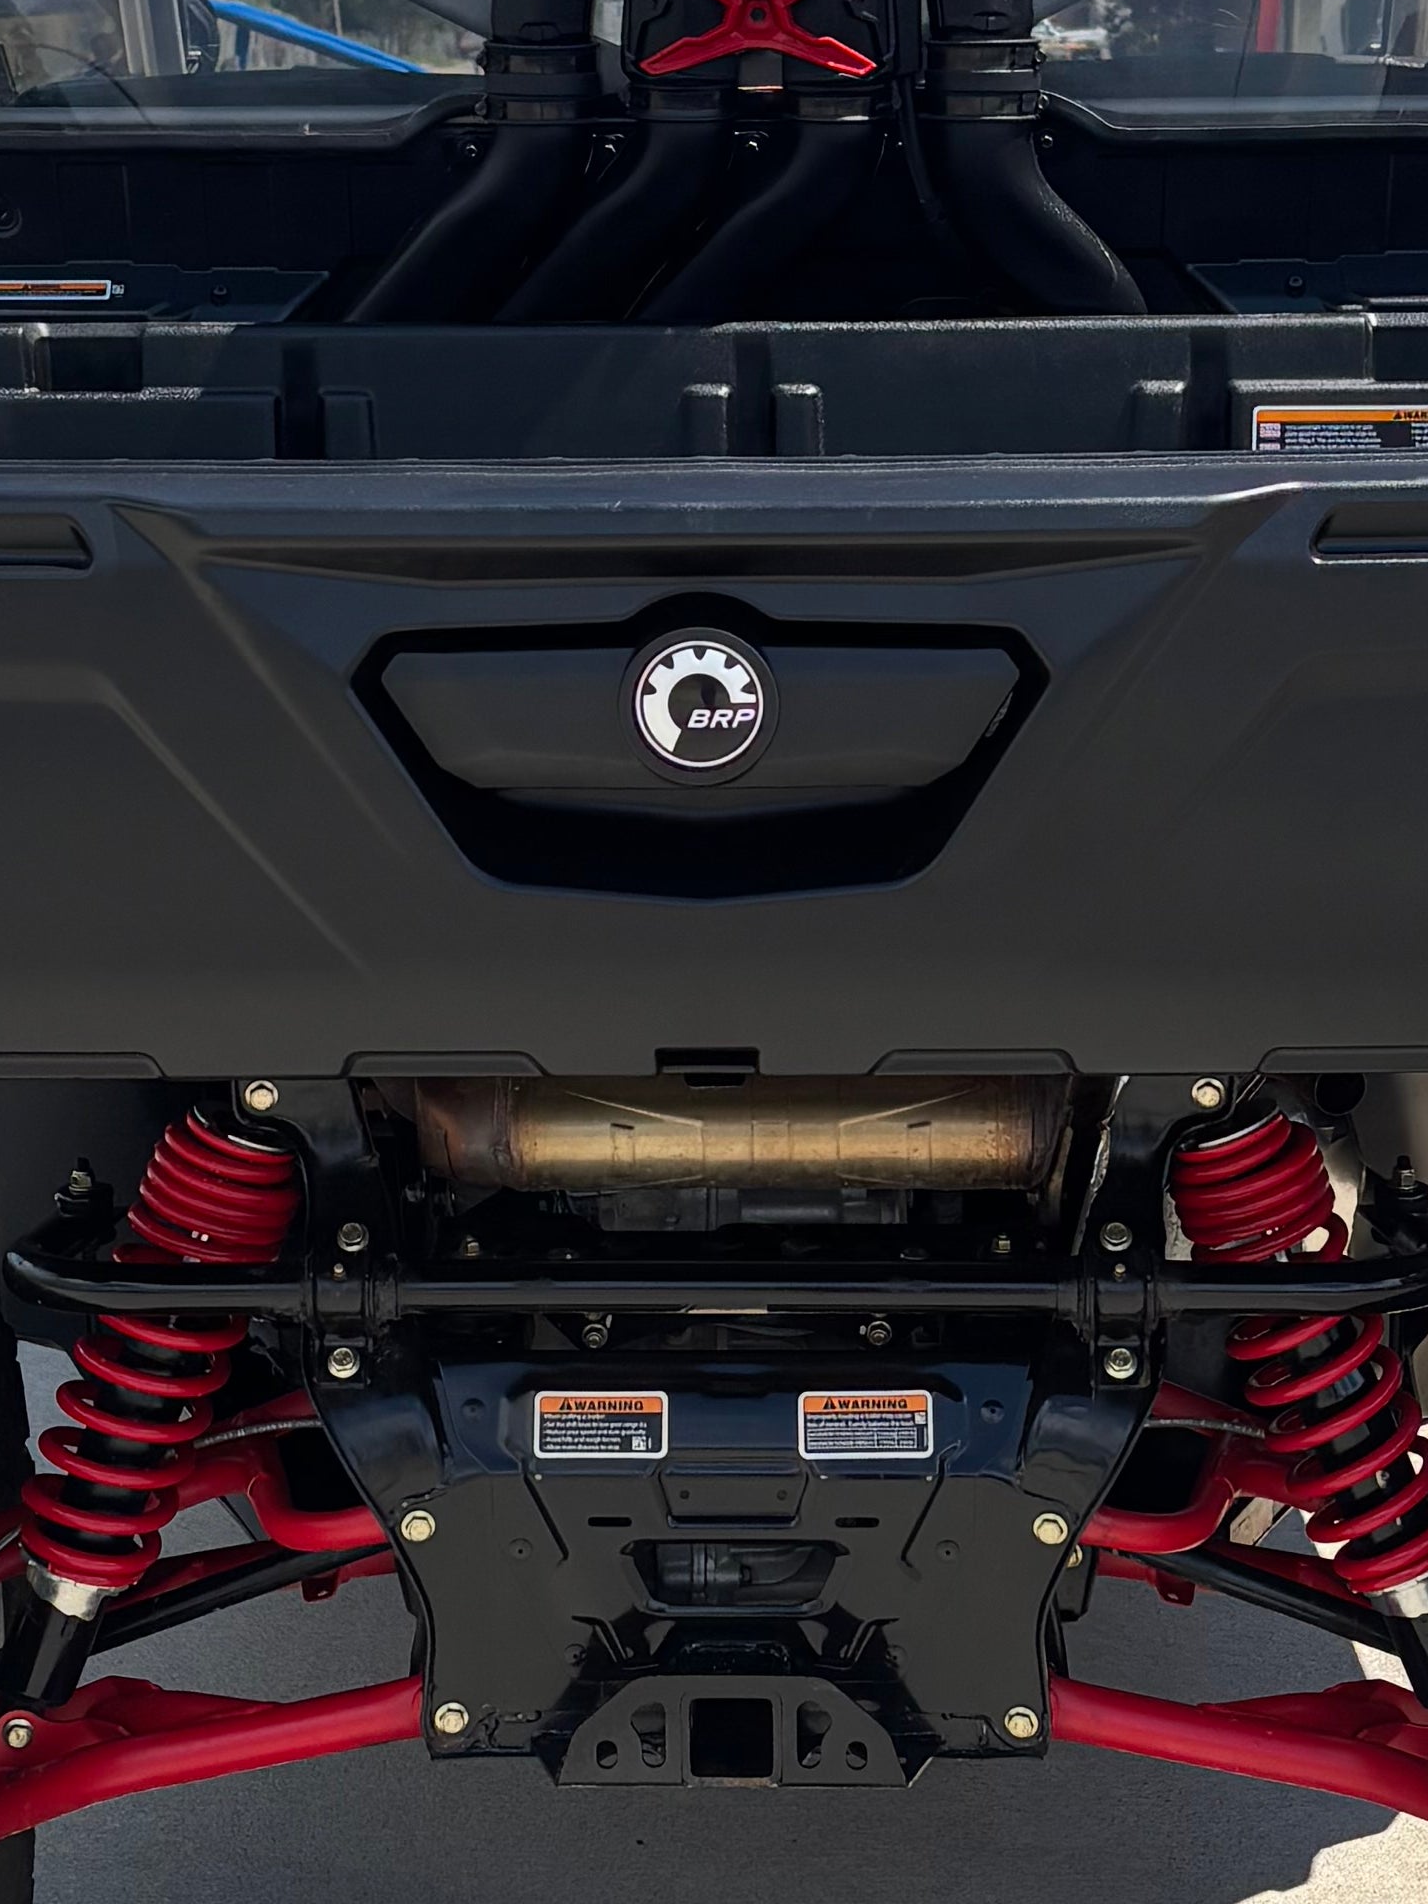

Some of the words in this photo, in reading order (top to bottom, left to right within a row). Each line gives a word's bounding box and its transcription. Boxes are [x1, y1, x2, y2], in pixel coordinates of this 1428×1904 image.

[687, 708, 756, 729] BRP
[574, 1400, 644, 1412] WARNING
[837, 1398, 908, 1410] WARNING
